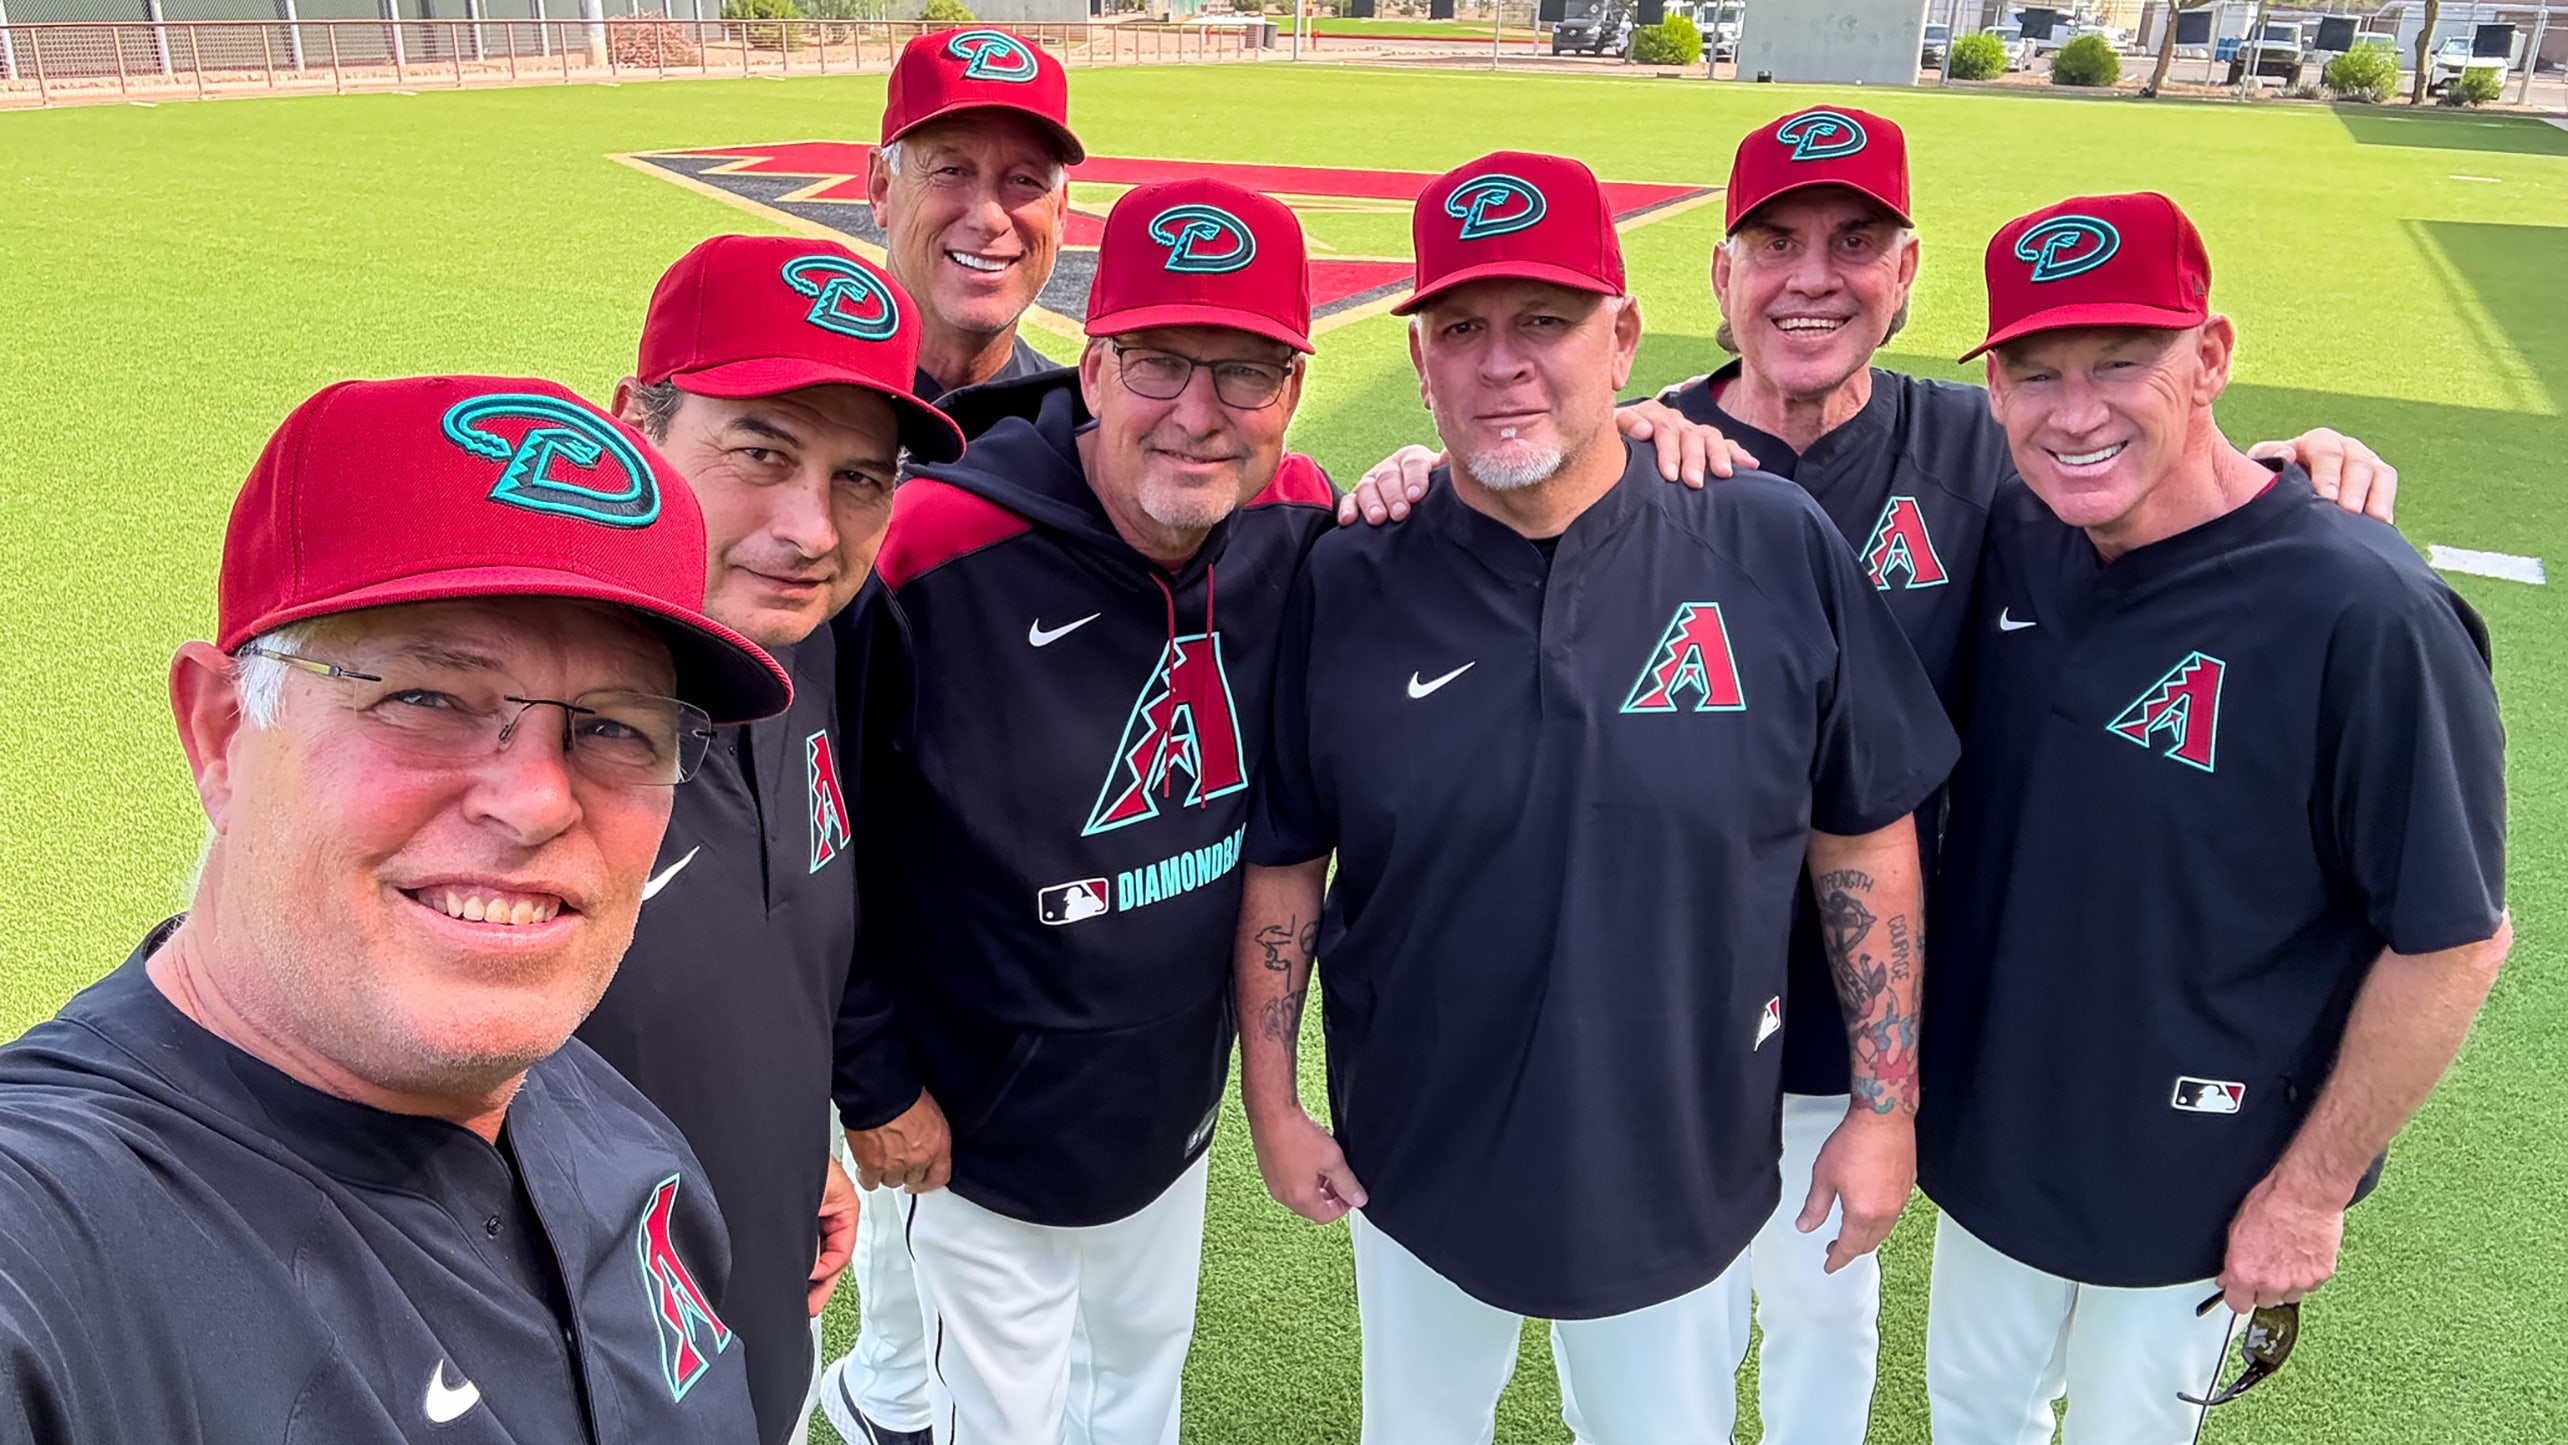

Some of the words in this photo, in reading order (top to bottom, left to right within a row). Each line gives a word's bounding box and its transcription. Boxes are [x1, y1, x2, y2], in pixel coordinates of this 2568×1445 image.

[1619, 601, 1747, 713] A
[2105, 650, 2226, 774] A
[1080, 631, 1249, 837] A
[1118, 822, 1247, 912] DIAMONDBA
